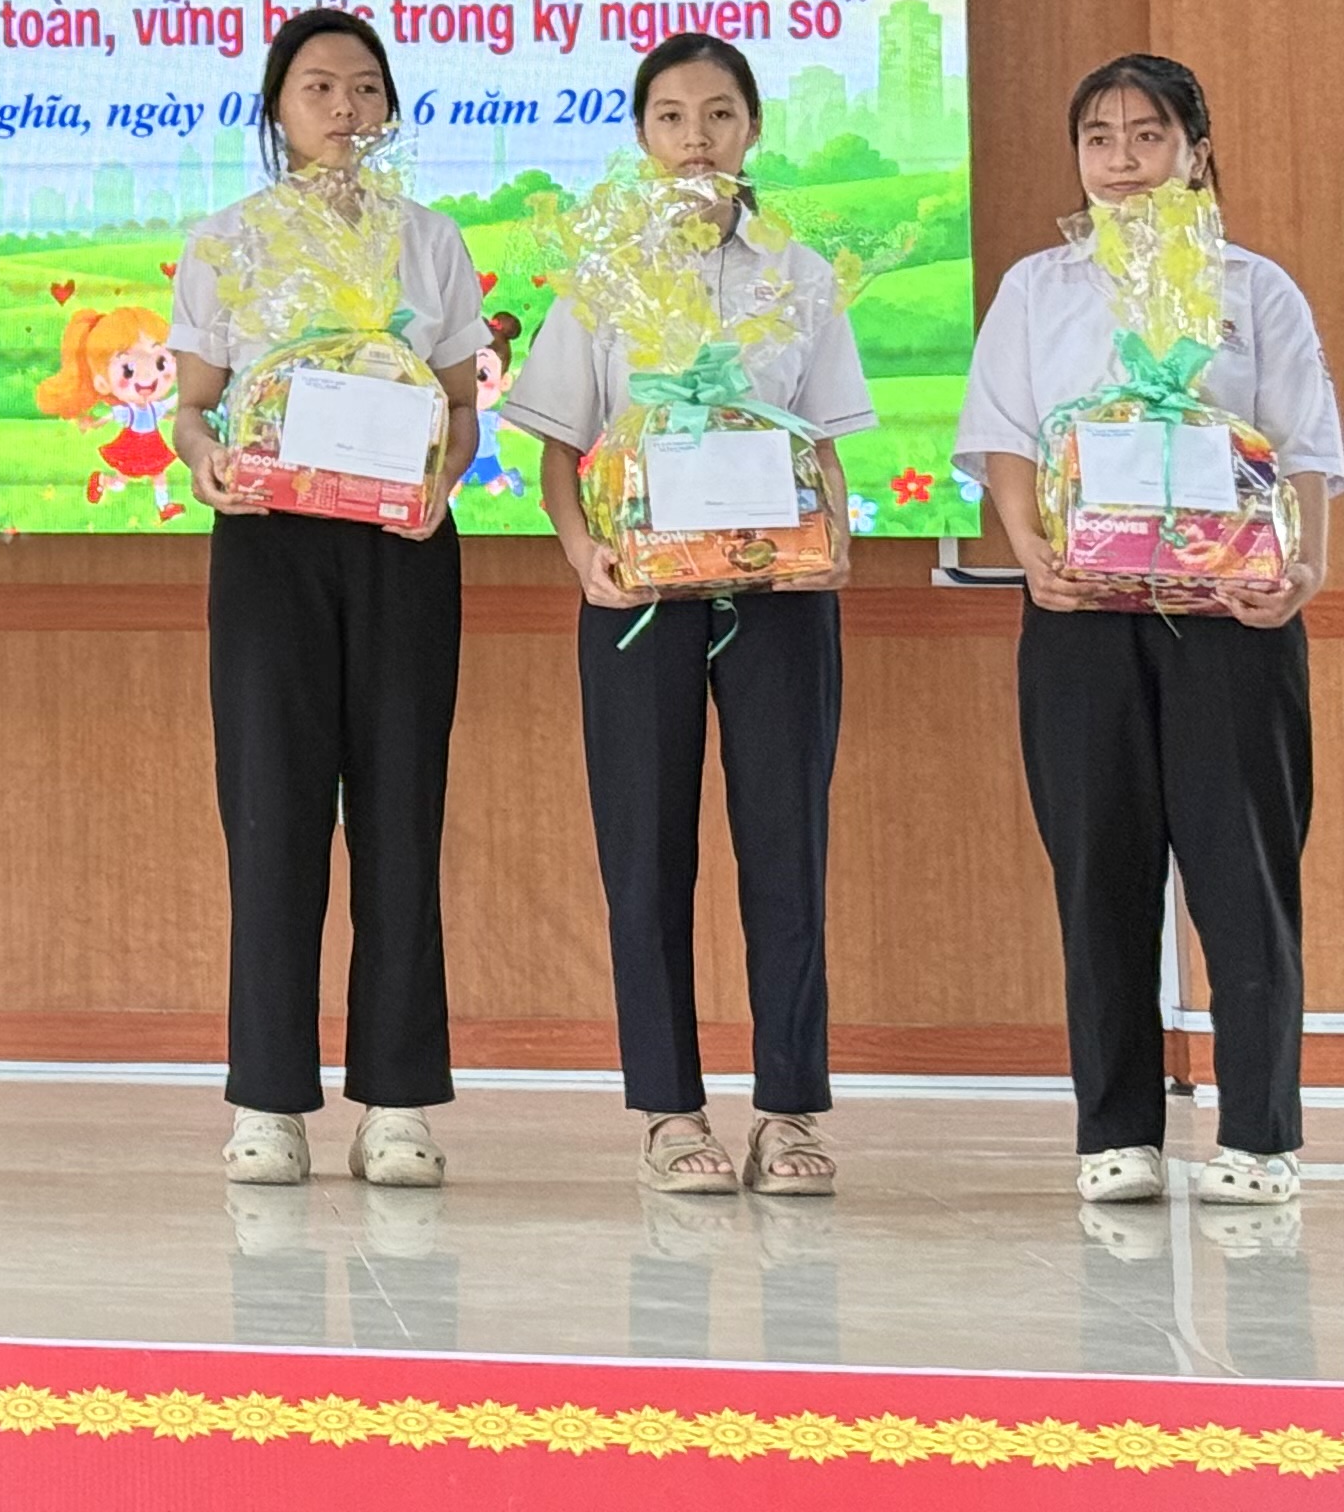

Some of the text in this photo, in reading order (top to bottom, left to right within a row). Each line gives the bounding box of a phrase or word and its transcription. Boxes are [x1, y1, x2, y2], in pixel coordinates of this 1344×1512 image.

[108, 92, 205, 138] ngày
[414, 89, 436, 126] 6
[449, 90, 540, 126] năm
[553, 88, 635, 125] 202
